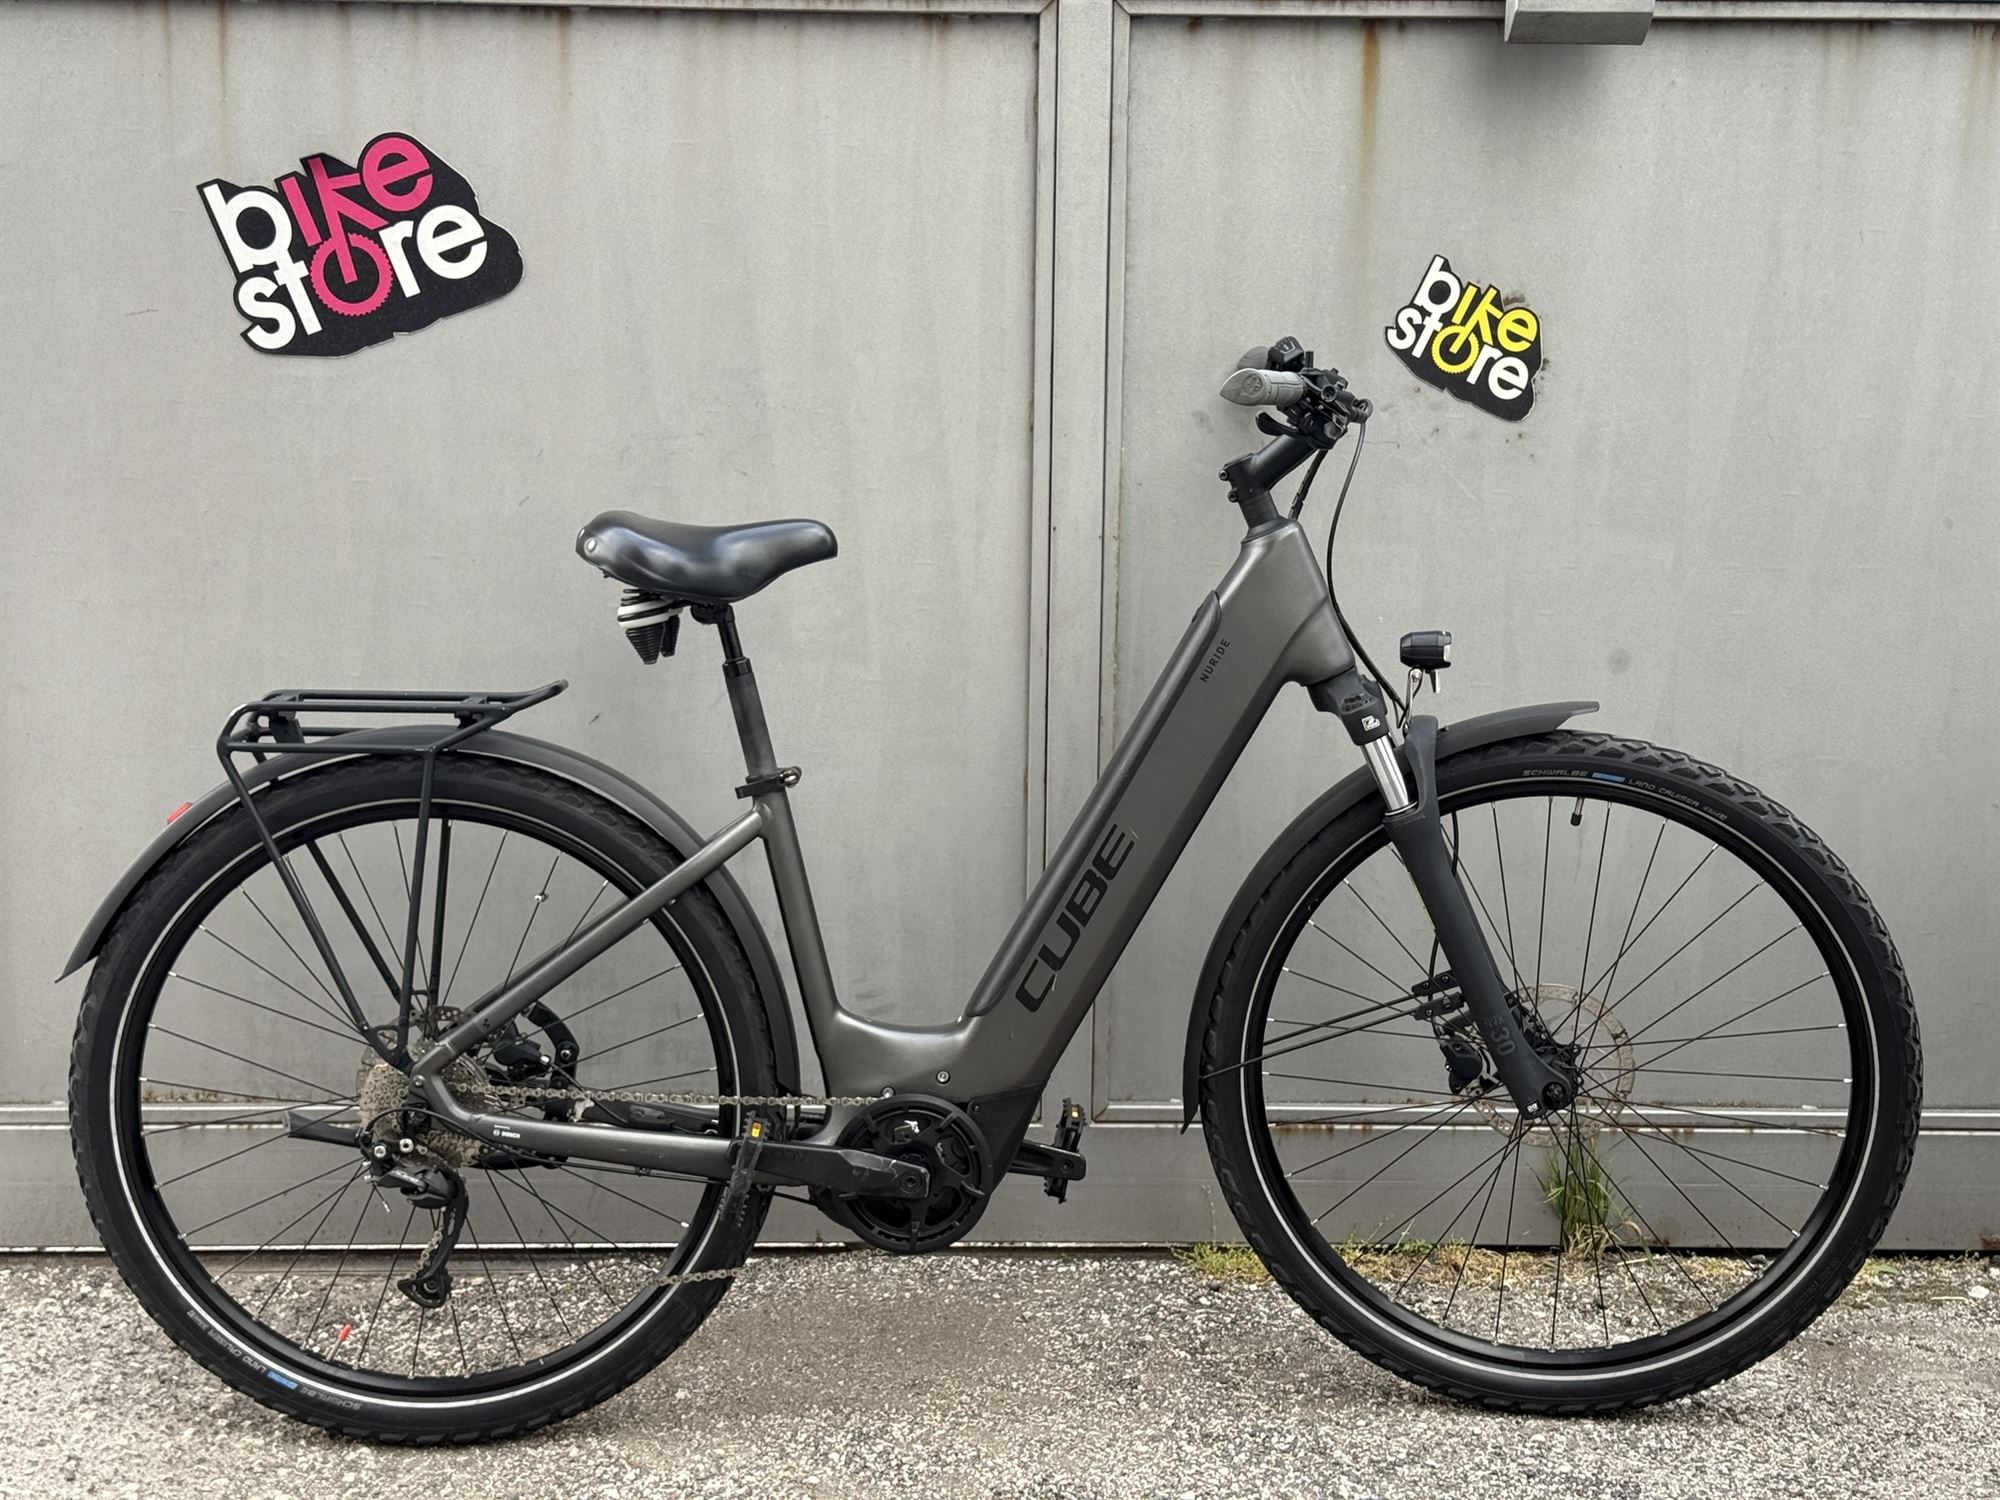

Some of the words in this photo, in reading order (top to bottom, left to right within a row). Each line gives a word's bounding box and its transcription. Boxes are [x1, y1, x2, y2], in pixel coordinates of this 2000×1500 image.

[202, 137, 433, 284] bike
[237, 204, 488, 350] store
[1413, 255, 1538, 353] bike
[1386, 307, 1529, 400] store
[1200, 638, 1230, 683] NURIDE
[1522, 768, 1589, 777] SCHWALBE
[1628, 778, 1656, 791] LAND
[1658, 786, 1701, 808] CRUISER
[1015, 823, 1136, 1013] CUBE
[1490, 1026, 1516, 1056] 30
[242, 1355, 267, 1375] LAND
